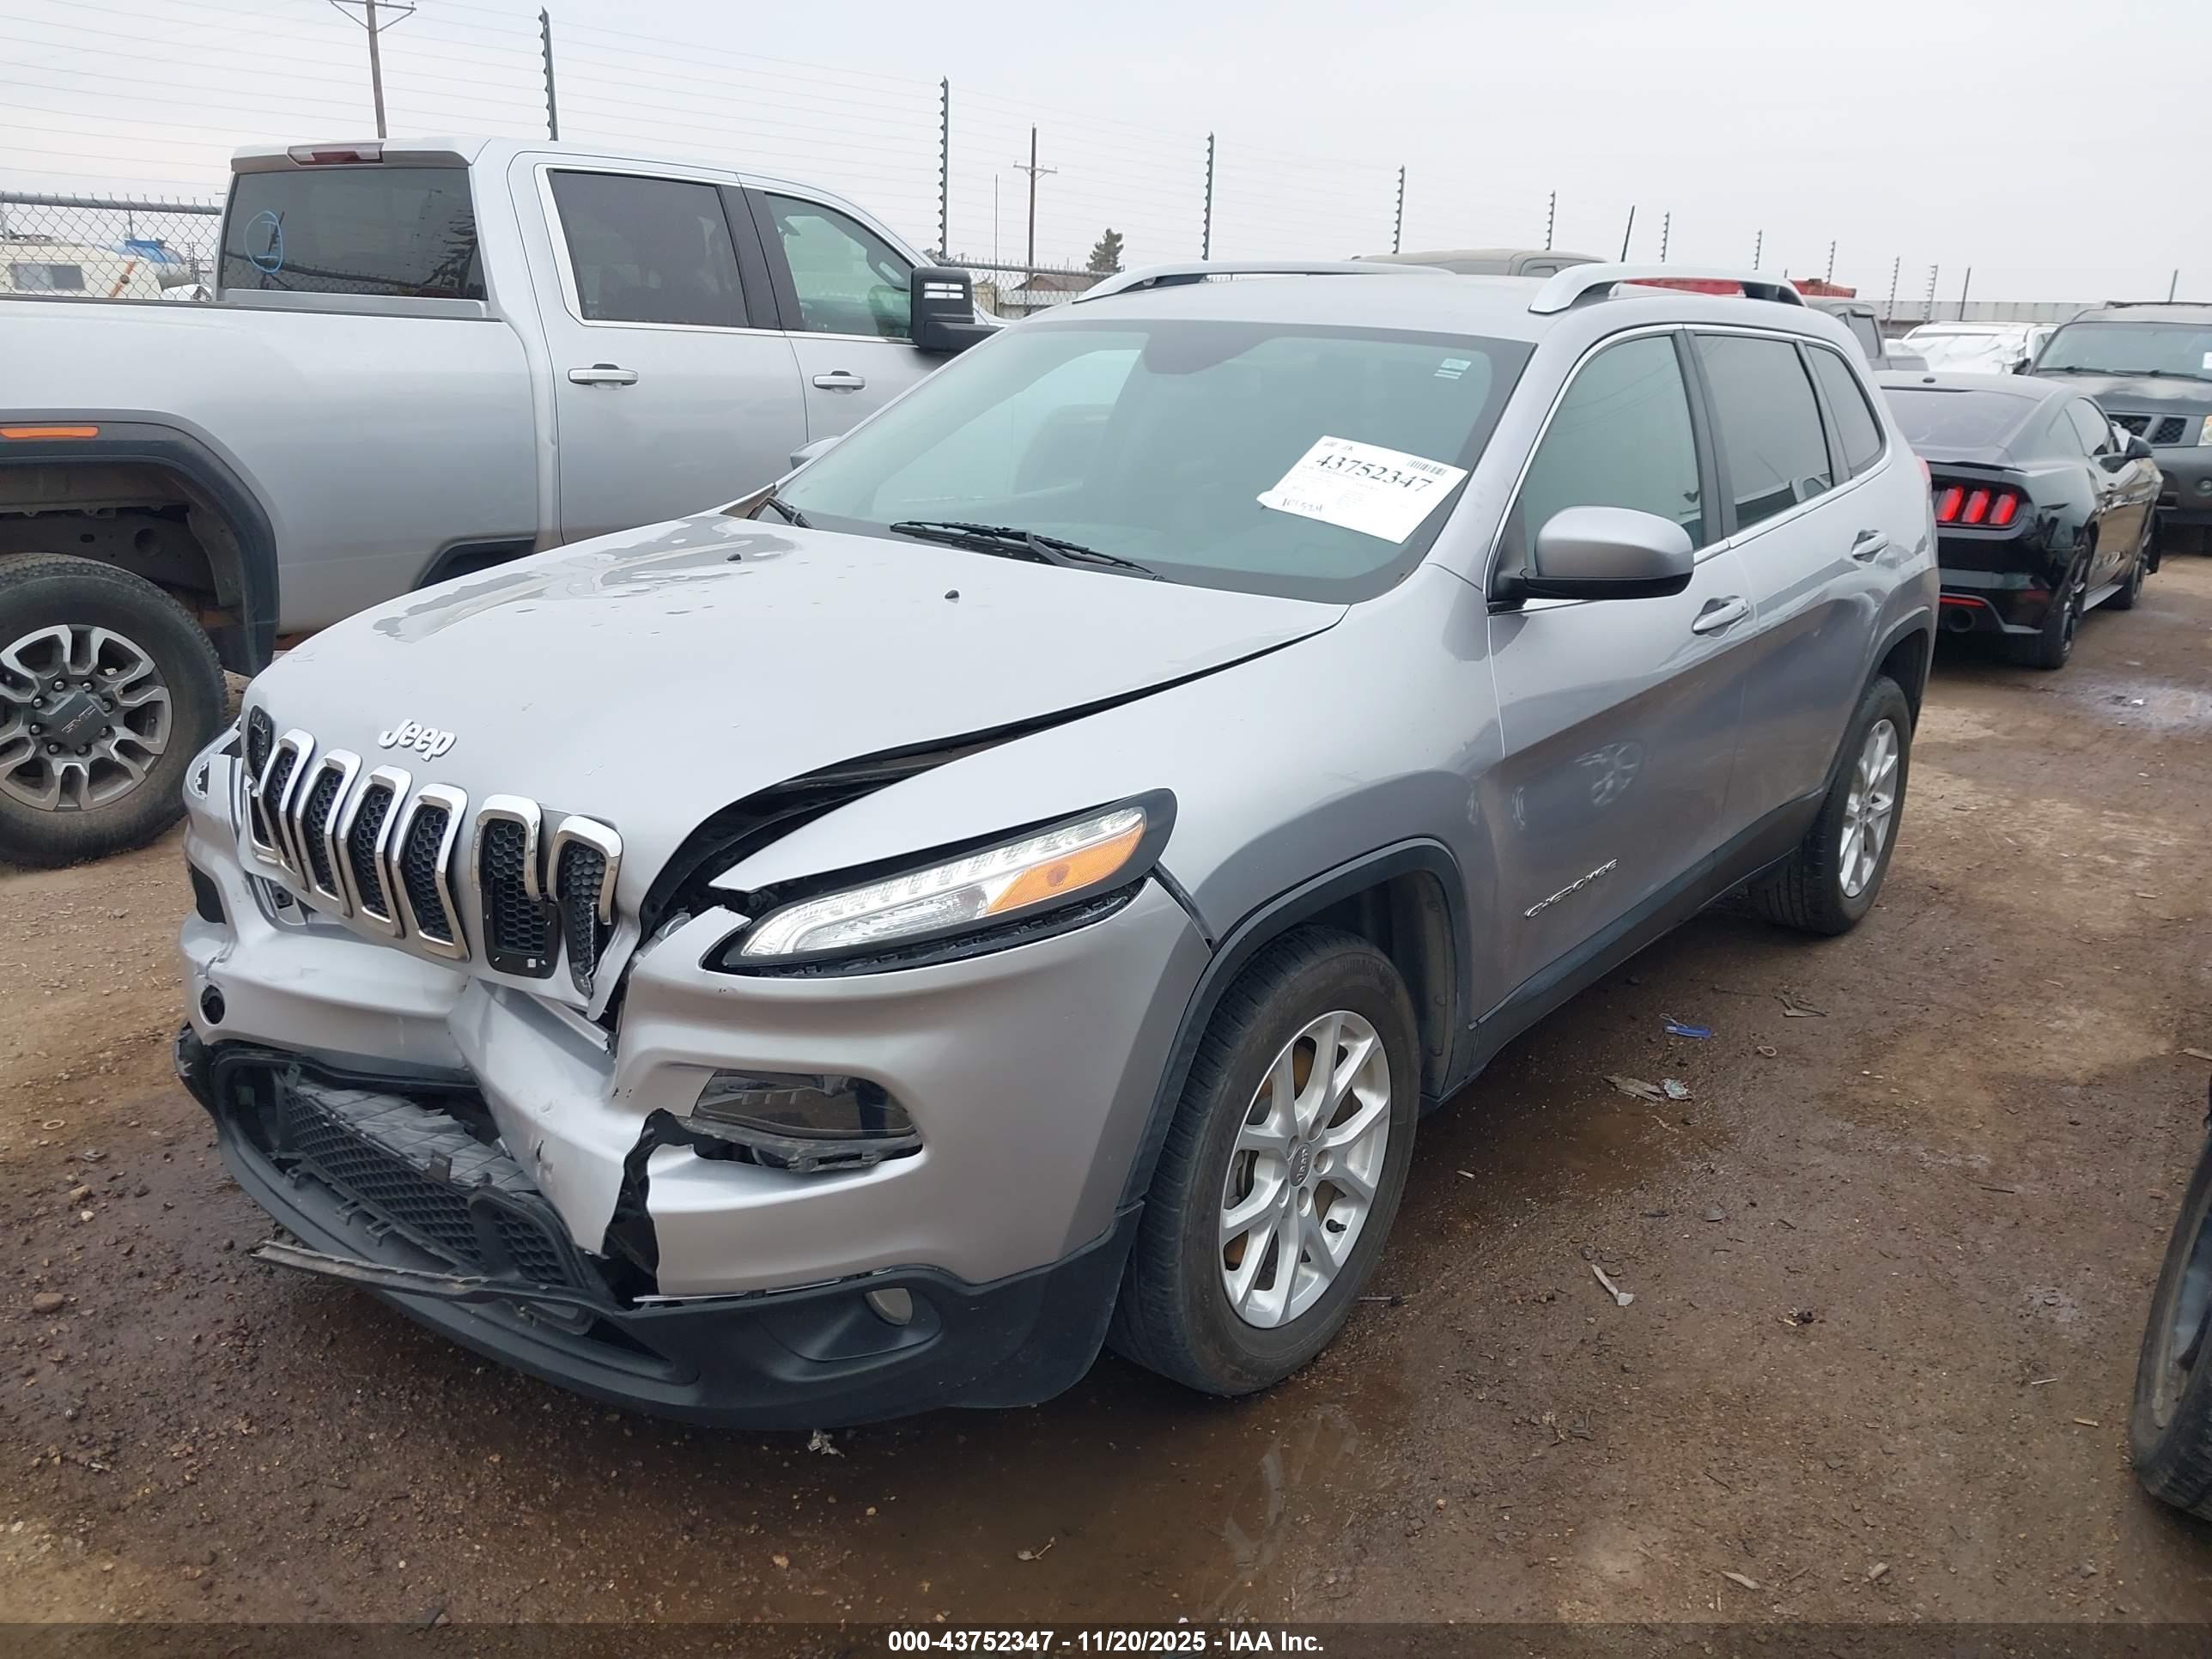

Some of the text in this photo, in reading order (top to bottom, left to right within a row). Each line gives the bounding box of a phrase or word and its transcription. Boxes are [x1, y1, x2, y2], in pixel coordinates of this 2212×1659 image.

[1316, 453, 1433, 492] 43752347
[61, 704, 96, 733] GMC
[378, 719, 457, 762] Jeep
